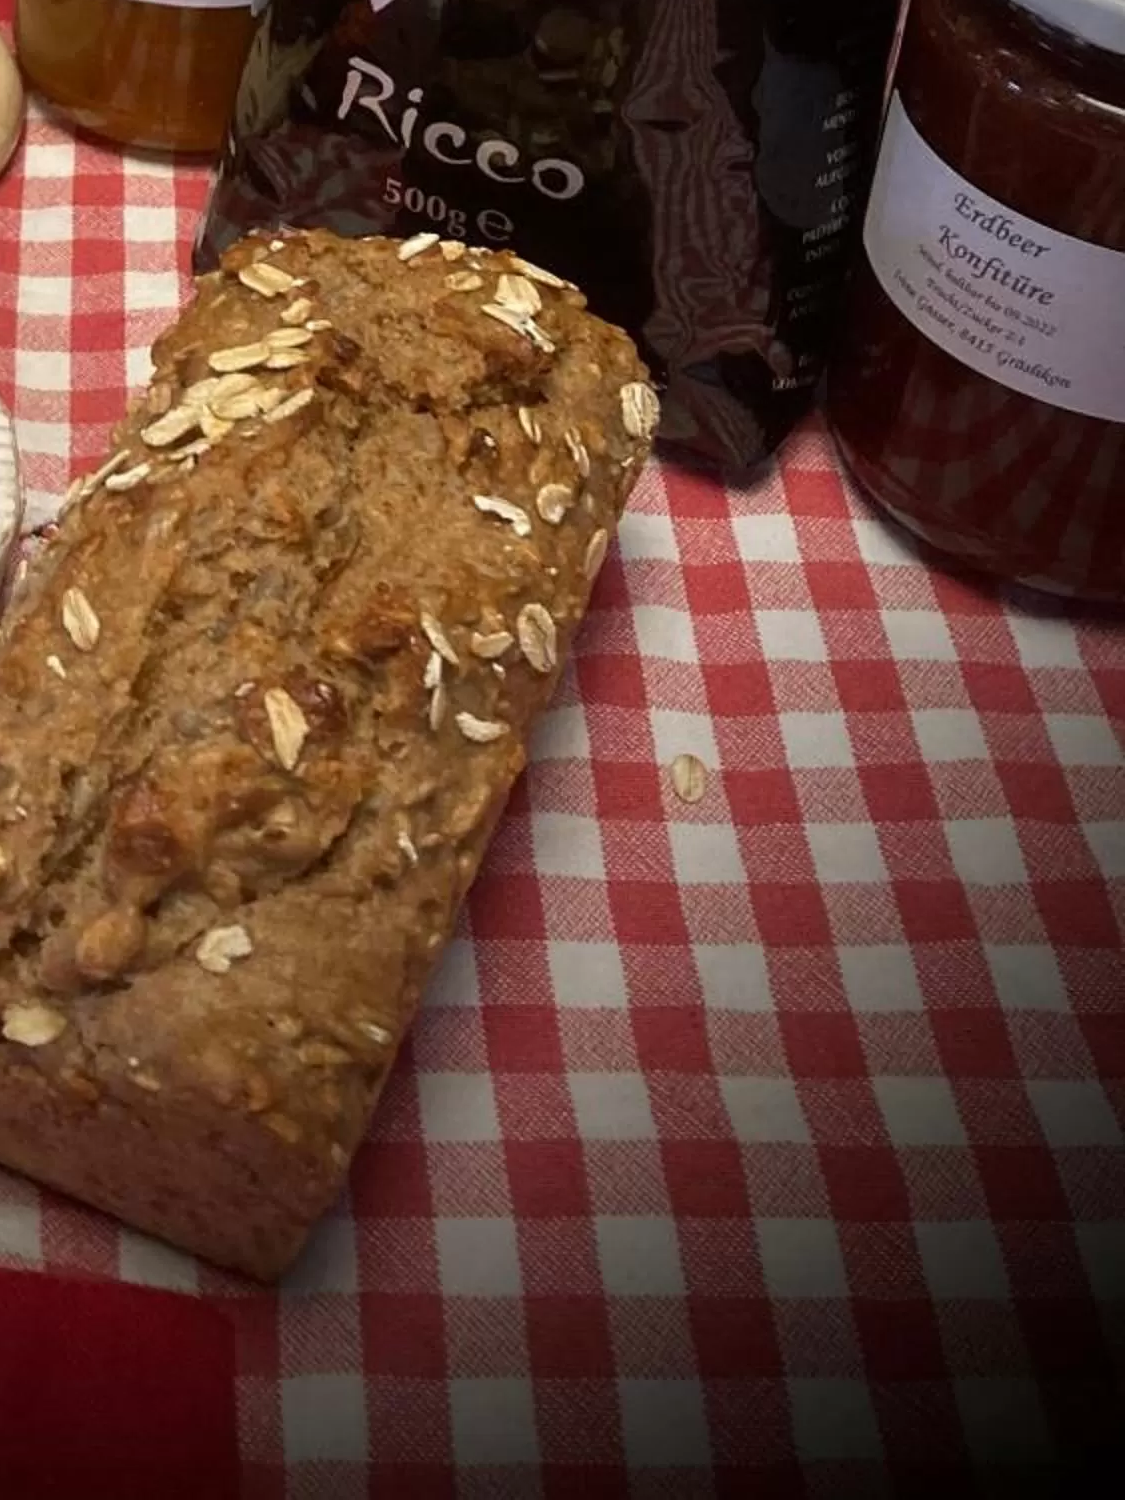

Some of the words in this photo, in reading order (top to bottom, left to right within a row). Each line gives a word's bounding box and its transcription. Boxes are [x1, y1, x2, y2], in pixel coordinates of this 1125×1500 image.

[337, 55, 585, 200] Ricco
[382, 177, 467, 238] 500g
[954, 191, 1053, 260] Erdbeer
[938, 224, 1057, 307] Konfitüre
